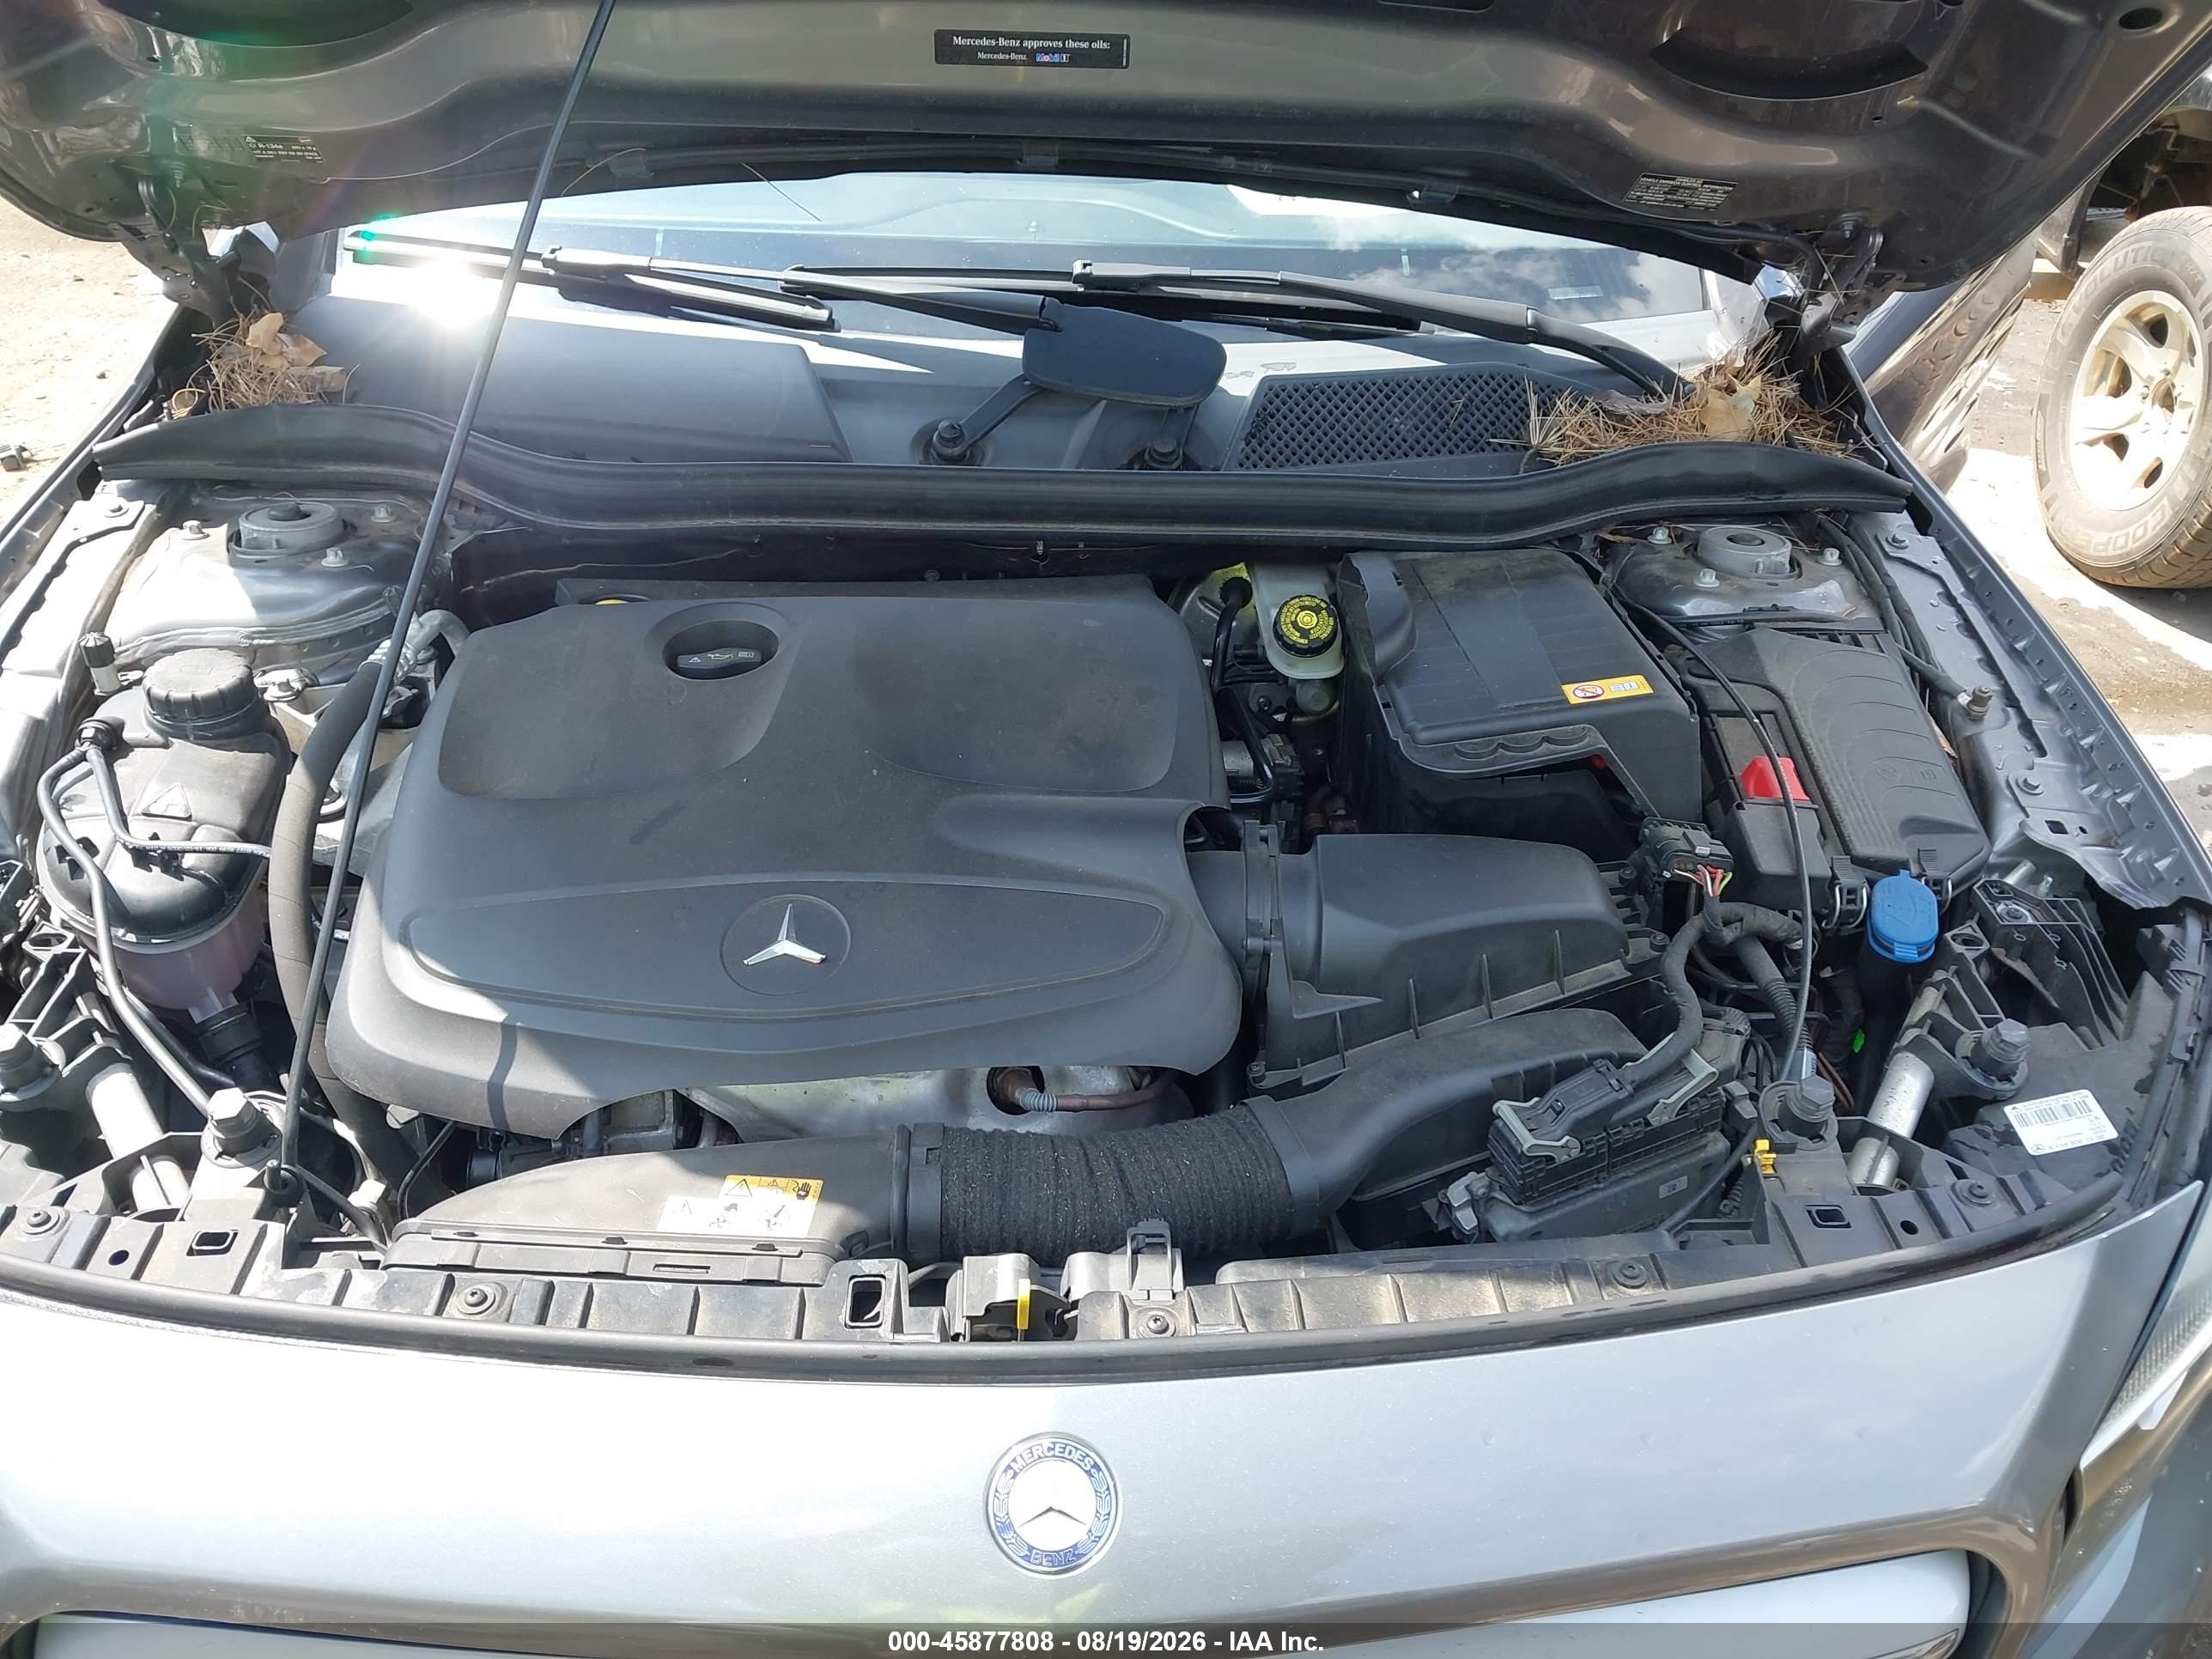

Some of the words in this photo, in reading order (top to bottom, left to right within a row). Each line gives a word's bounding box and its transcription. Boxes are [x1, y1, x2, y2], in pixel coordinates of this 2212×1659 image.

[952, 35, 1021, 47] Mercedes-Benz
[1022, 38, 1063, 49] approves
[1065, 38, 1090, 48] these
[1091, 39, 1110, 49] oils:
[977, 51, 1027, 61] Mercedes-Benz
[1036, 53, 1060, 63] Mobil
[1011, 1442, 1095, 1473] MERCEDES
[1030, 1548, 1077, 1566] BENZ
